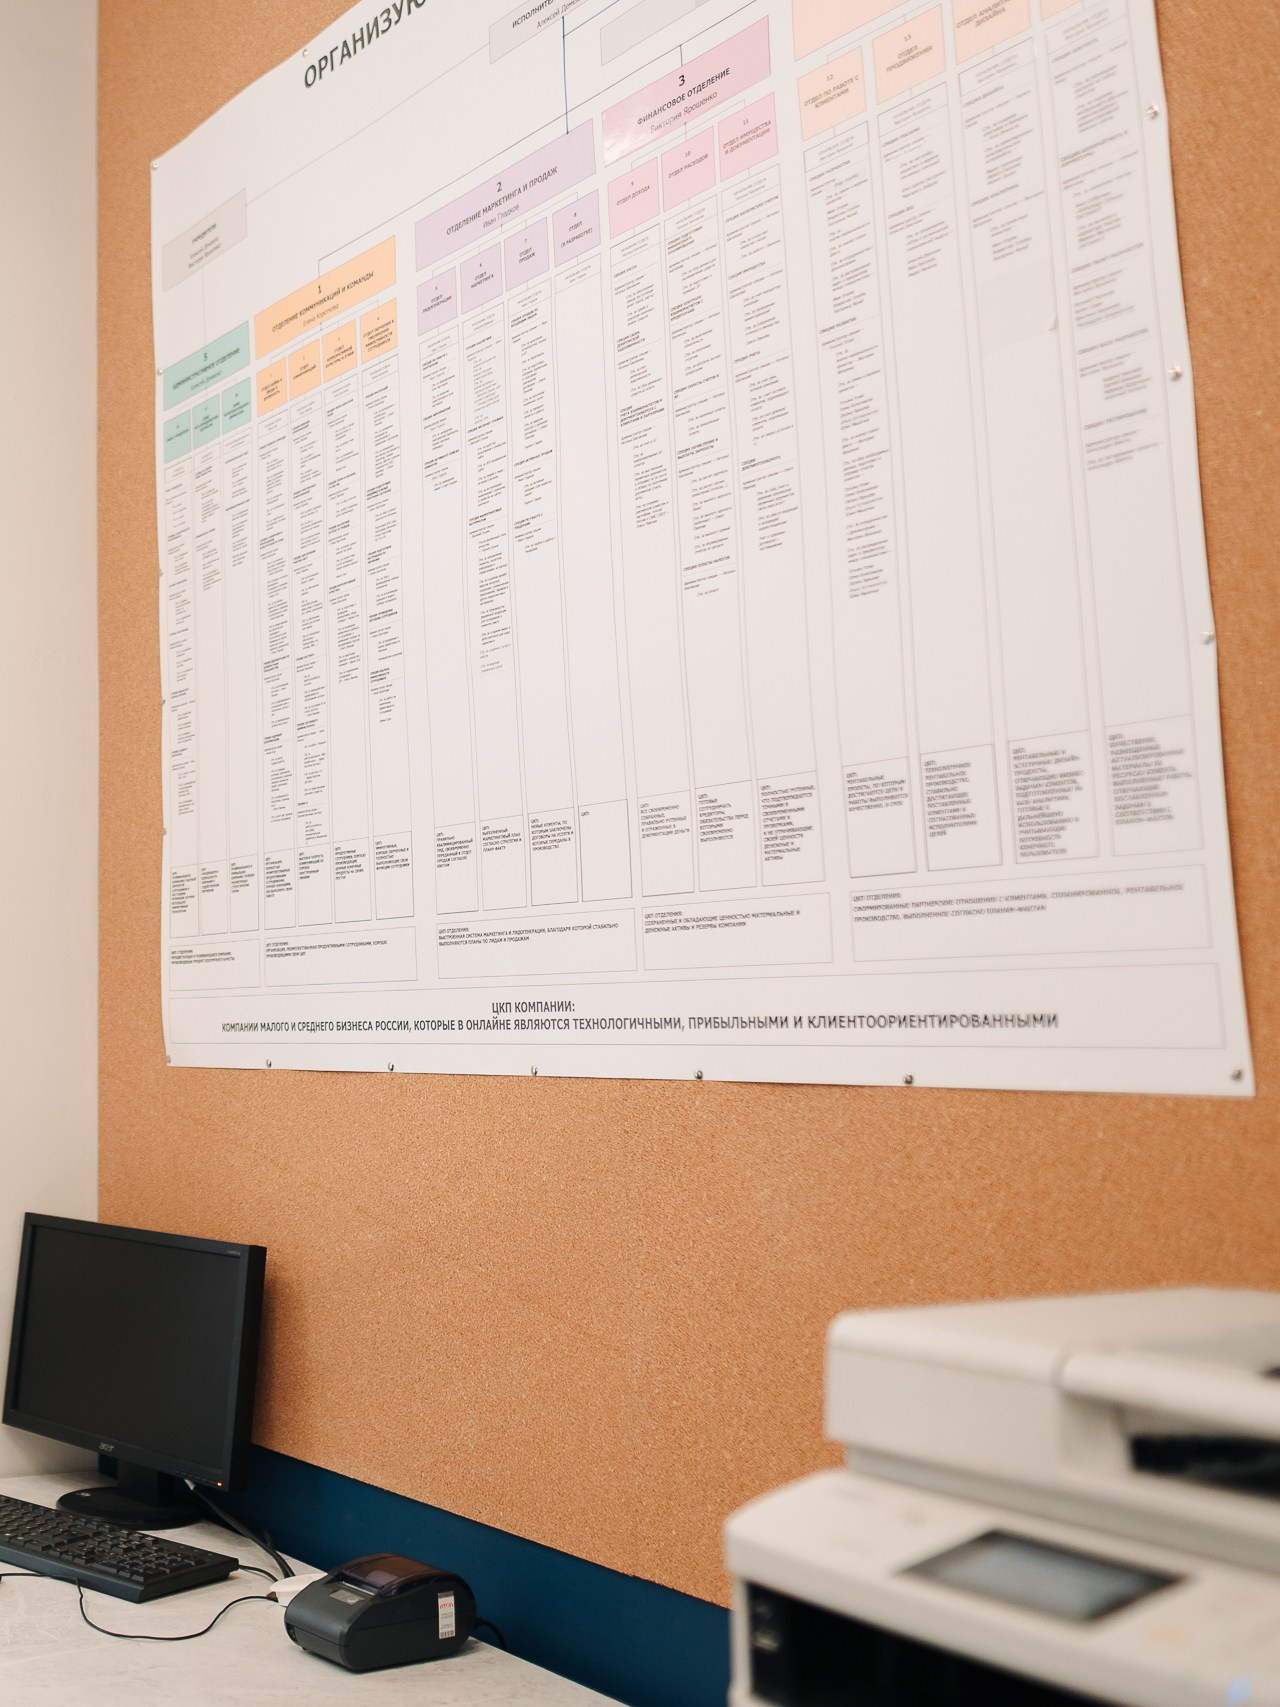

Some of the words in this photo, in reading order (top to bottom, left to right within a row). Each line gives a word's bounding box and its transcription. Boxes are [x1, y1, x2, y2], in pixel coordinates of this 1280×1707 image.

[678, 74, 686, 87] 3
[637, 92, 686, 126] ФИНАНСОВОЕ
[687, 67, 730, 98] ОТДЕЛЕНИЕ
[823, 88, 832, 98] ПО
[496, 182, 502, 192] 2
[446, 210, 481, 235] ОТДЕЛЕНИЕ
[482, 187, 522, 215] МАРКЕТИНГА
[523, 183, 528, 192] И
[529, 166, 558, 188] ПРОДАЖ
[318, 285, 322, 294] 1
[272, 313, 298, 332] ОТДЕЛЕНИЕ
[492, 1002, 512, 1015] ЦКП
[514, 1000, 575, 1013] КОМПАНИИ:
[221, 1022, 259, 1033] КОМПАНИИ
[260, 1021, 290, 1032] МАЛОГО
[291, 1021, 296, 1032] И
[298, 1021, 334, 1034] СРЕДНЕГО
[336, 1020, 373, 1032] БИЗНЕСА
[375, 1020, 412, 1033] РОССИИ,
[414, 1019, 456, 1031] КОТОРЫЕ
[458, 1019, 464, 1031] В
[466, 1016, 511, 1031] ОНЛАЙНЕ
[513, 1018, 570, 1030] ЯВЛЯЮТСЯ
[572, 1016, 685, 1032] ТЕХНОЛОГИЧНЫМИ,
[688, 1015, 789, 1031] ПРИБЫЛЬНЫМИ
[793, 1015, 803, 1029] И
[808, 1013, 1059, 1030] КЛИЕНТООРИЕНТИРОВАННЫМИ
